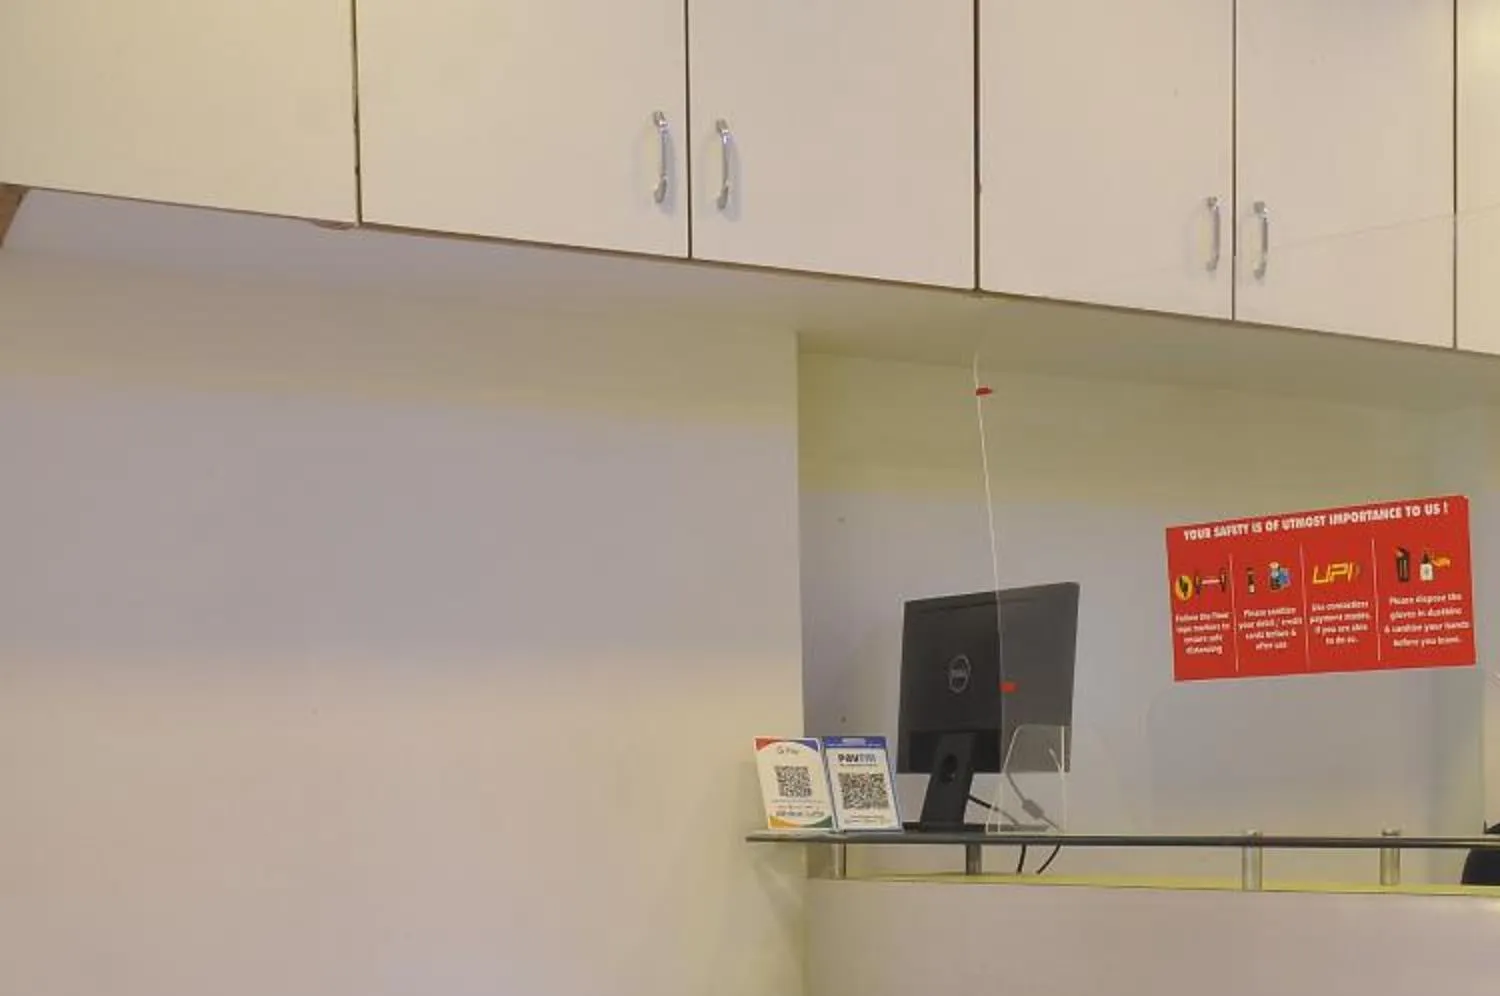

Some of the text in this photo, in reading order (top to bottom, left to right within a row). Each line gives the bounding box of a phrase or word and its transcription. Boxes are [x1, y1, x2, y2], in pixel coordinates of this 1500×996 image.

[1184, 529, 1211, 541] YOUR
[1214, 524, 1249, 537] SAFETY
[1251, 521, 1262, 533] IS
[1265, 519, 1279, 532] OF
[1282, 515, 1326, 530] UTMOST
[1329, 507, 1403, 525] IMPORTANCE
[1405, 505, 1421, 518] TO
[1424, 503, 1441, 515] US
[1312, 562, 1353, 584] UPI
